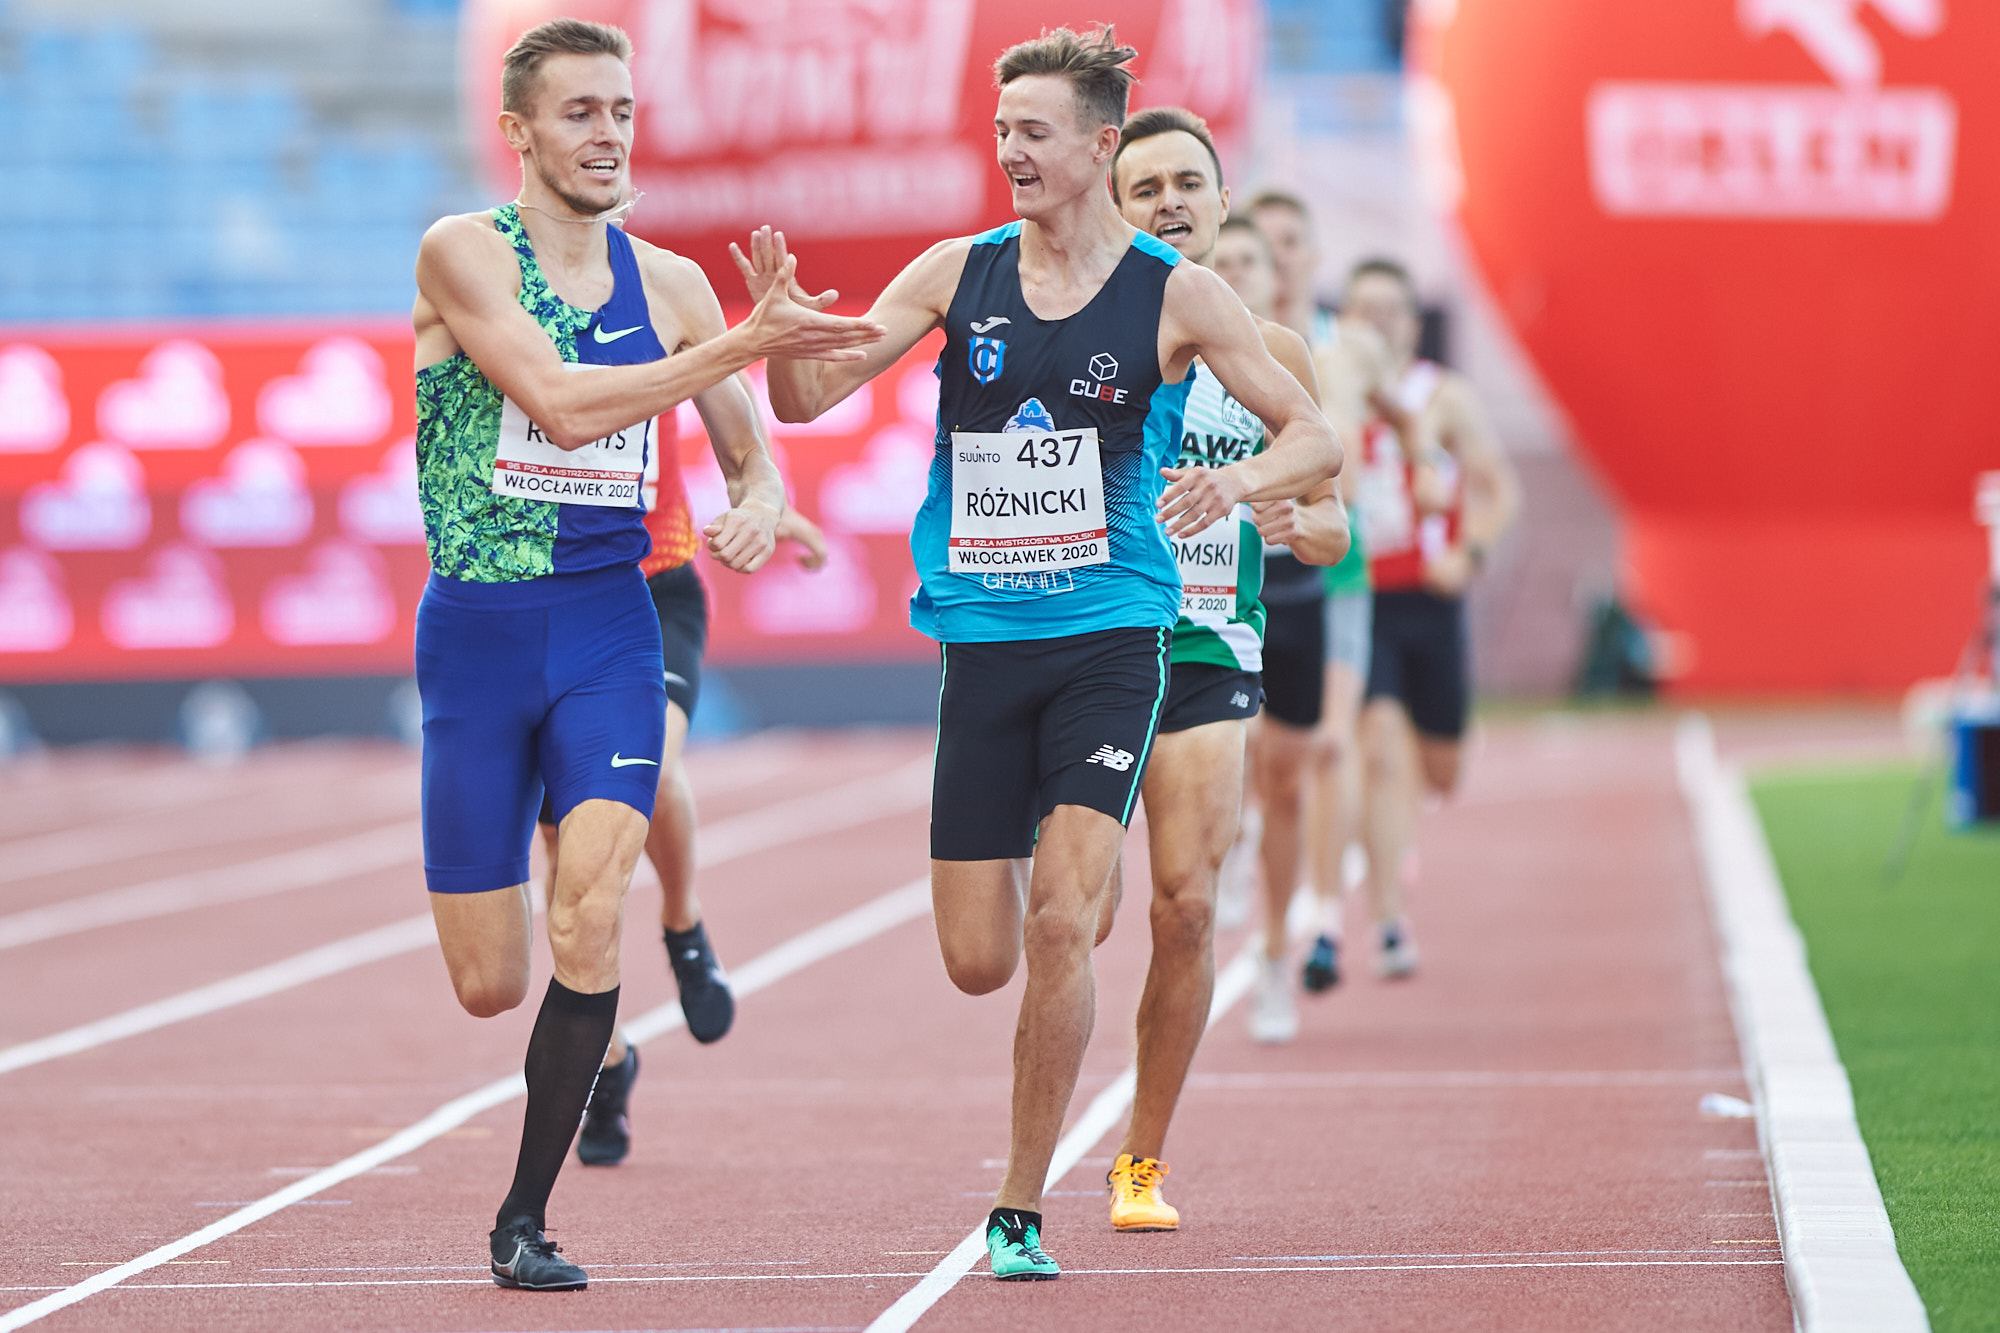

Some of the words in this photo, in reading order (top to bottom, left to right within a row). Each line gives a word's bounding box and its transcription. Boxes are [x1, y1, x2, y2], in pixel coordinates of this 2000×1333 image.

[1069, 379, 1129, 405] CUBE
[959, 452, 1001, 463] SUUNTO
[1016, 434, 1083, 469] 437
[523, 465, 548, 475] PZLA
[549, 468, 610, 479] MISTRZOSTWA
[504, 473, 604, 497] WŁOCŁAWEK
[967, 486, 1087, 517] RÓŻNICKI
[973, 539, 995, 547] PZLA
[995, 535, 1062, 548] MISTRZOSTWA
[1063, 531, 1096, 543] POLSKI
[958, 548, 1057, 565] WŁOCŁAWEK
[1061, 543, 1098, 561] 2020
[982, 570, 1062, 590] GRANIT
[1197, 597, 1228, 611] 2020
